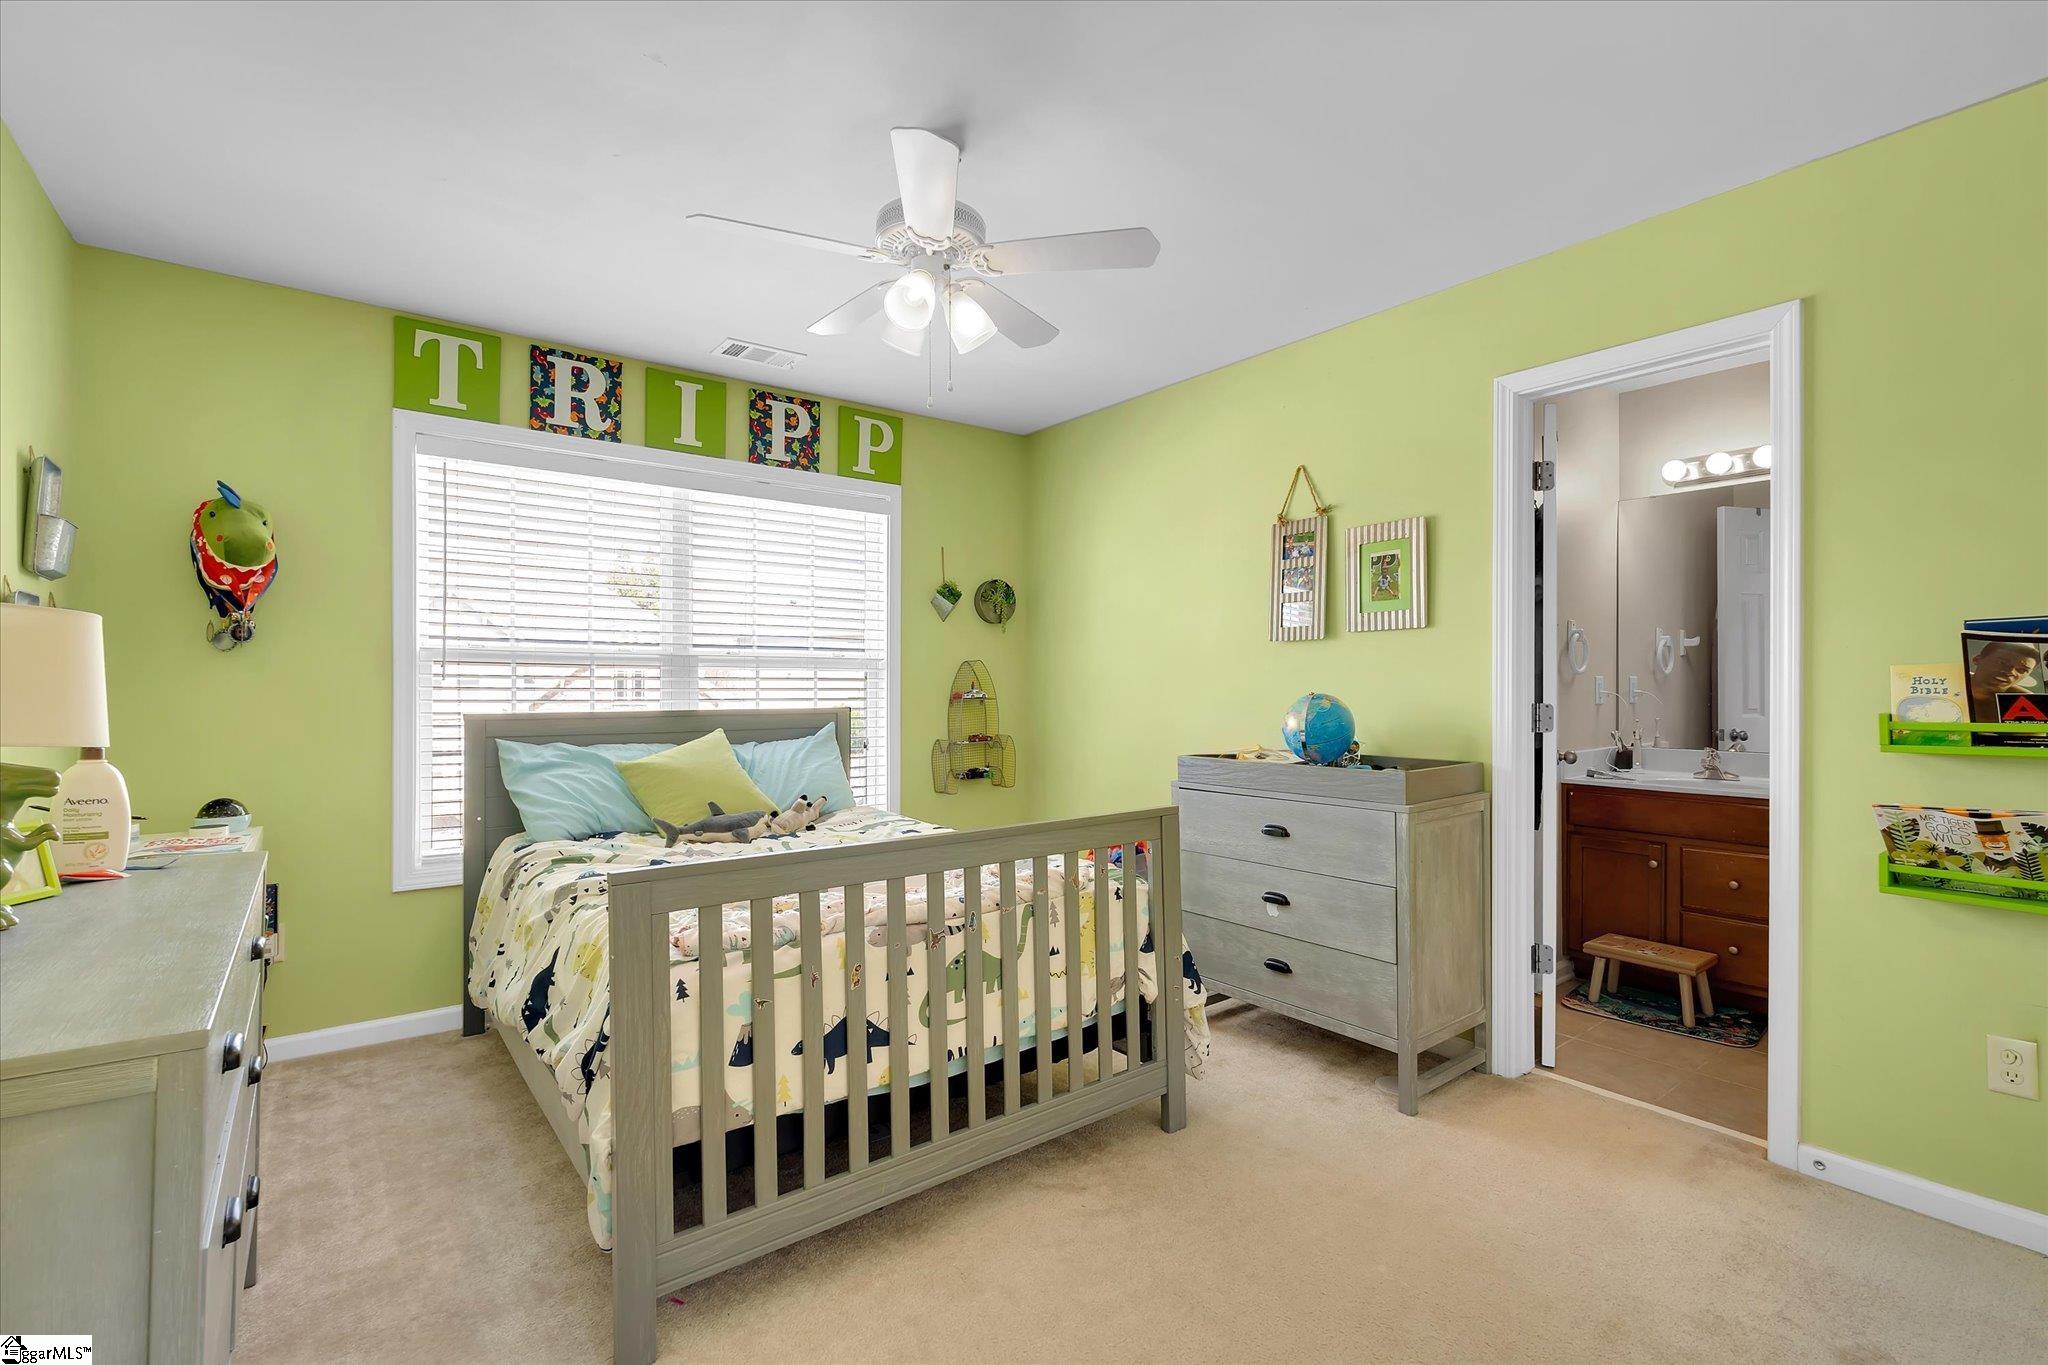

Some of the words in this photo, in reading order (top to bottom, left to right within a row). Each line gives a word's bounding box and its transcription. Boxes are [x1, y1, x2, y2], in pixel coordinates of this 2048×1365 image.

[1912, 676, 1947, 685] HOLY
[1910, 686, 1949, 695] BIBLE
[63, 797, 108, 806] Aveeno
[1940, 816, 1972, 828] TIGER
[1925, 821, 1971, 837] GOES
[1930, 831, 1972, 846] WILD
